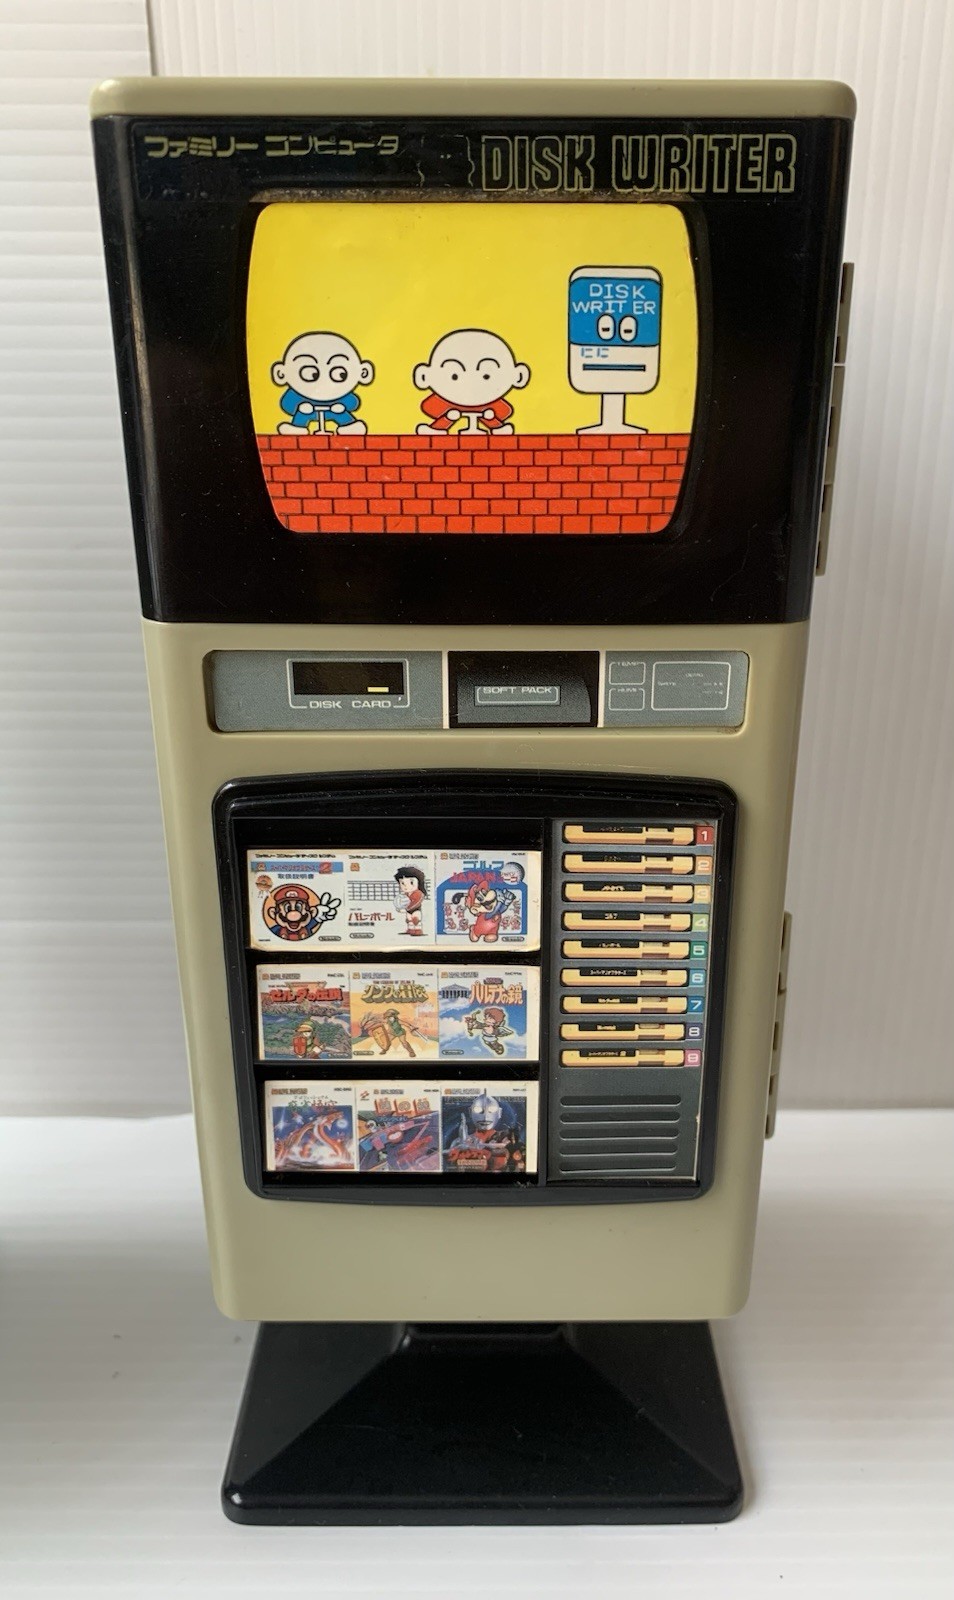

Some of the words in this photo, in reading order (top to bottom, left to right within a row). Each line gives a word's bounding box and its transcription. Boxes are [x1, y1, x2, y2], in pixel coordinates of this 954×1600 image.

[144, 136, 259, 158] ファミリー
[265, 135, 400, 157] コンピュータ
[482, 135, 595, 193] DISK
[611, 133, 798, 194] WRITER
[589, 284, 646, 299] DISK
[482, 686, 517, 694] SOFT
[521, 686, 552, 694] PACK
[309, 700, 342, 709] DISK
[352, 700, 392, 709] CARD
[700, 830, 708, 842] 1
[463, 860, 504, 871] ゴルフ
[697, 859, 709, 871] 2
[694, 916, 706, 927] 4
[693, 945, 704, 956] 5
[691, 973, 704, 984] 6
[468, 980, 523, 1005] パルテナの鏡
[690, 1000, 702, 1010] 7
[688, 1027, 700, 1037] 8
